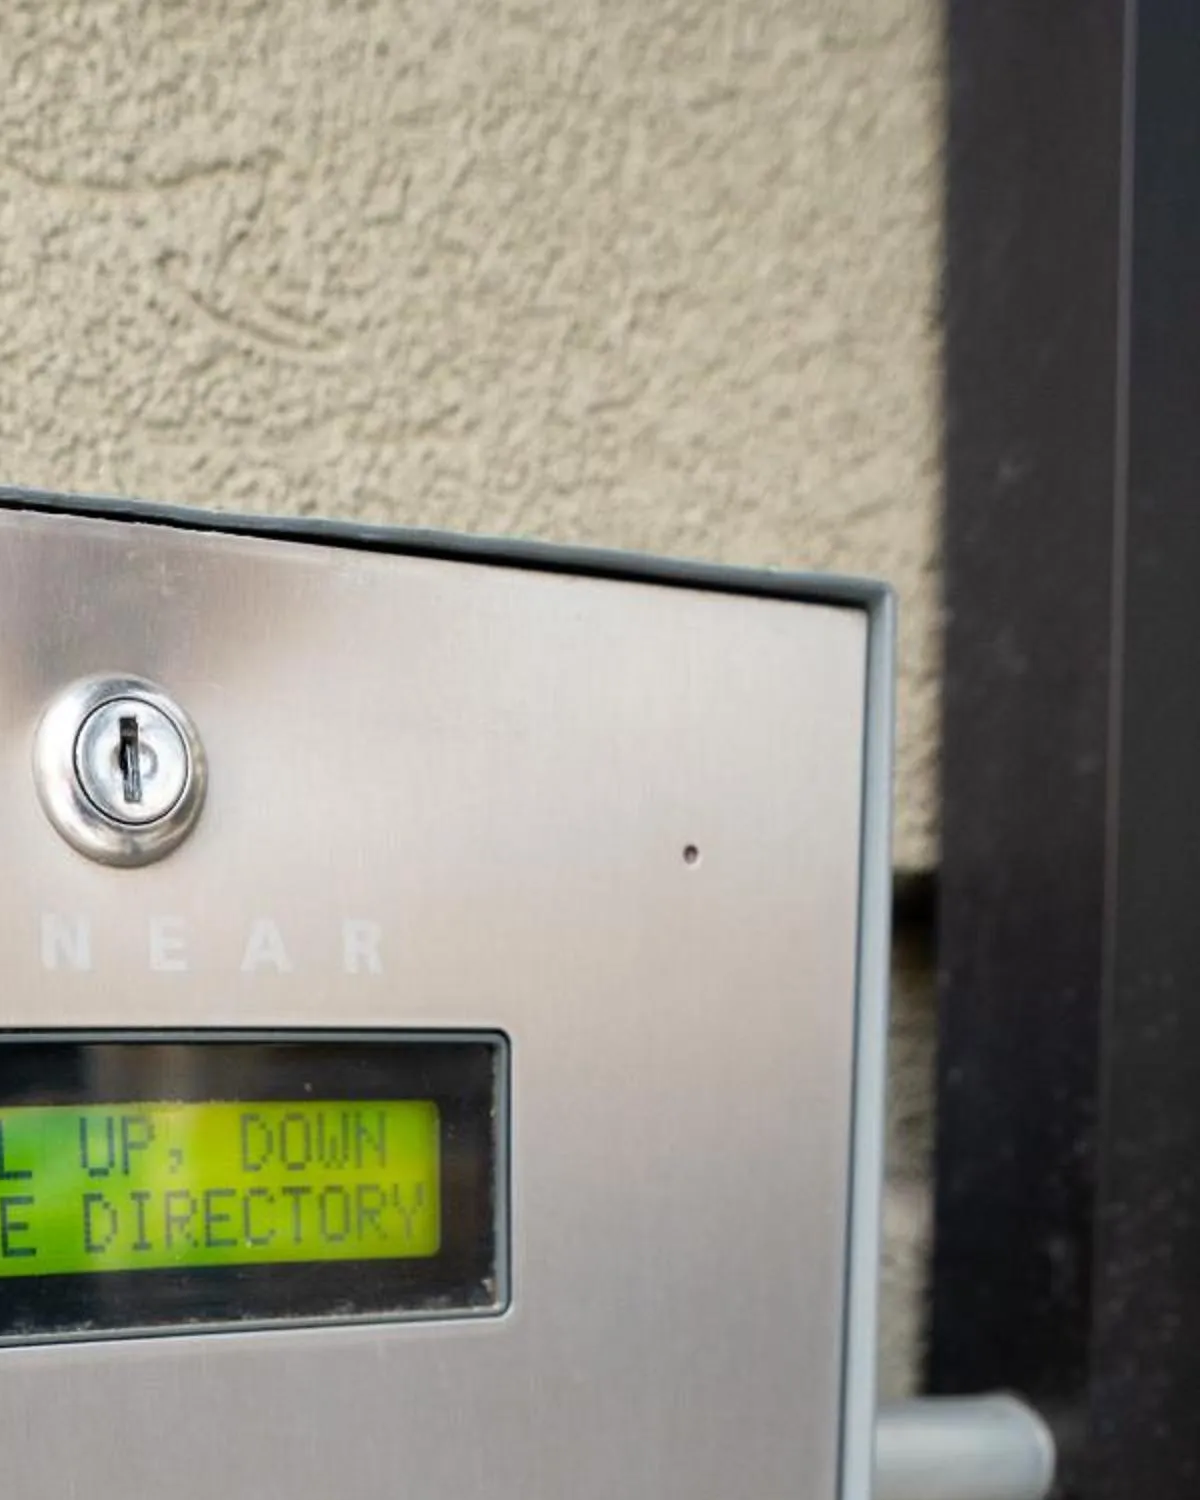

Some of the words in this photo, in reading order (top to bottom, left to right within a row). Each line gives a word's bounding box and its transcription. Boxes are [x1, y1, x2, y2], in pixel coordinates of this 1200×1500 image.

[79, 1114, 183, 1177] UP,
[240, 1110, 387, 1174] DOWN
[83, 1180, 426, 1254] DIRECTORY
